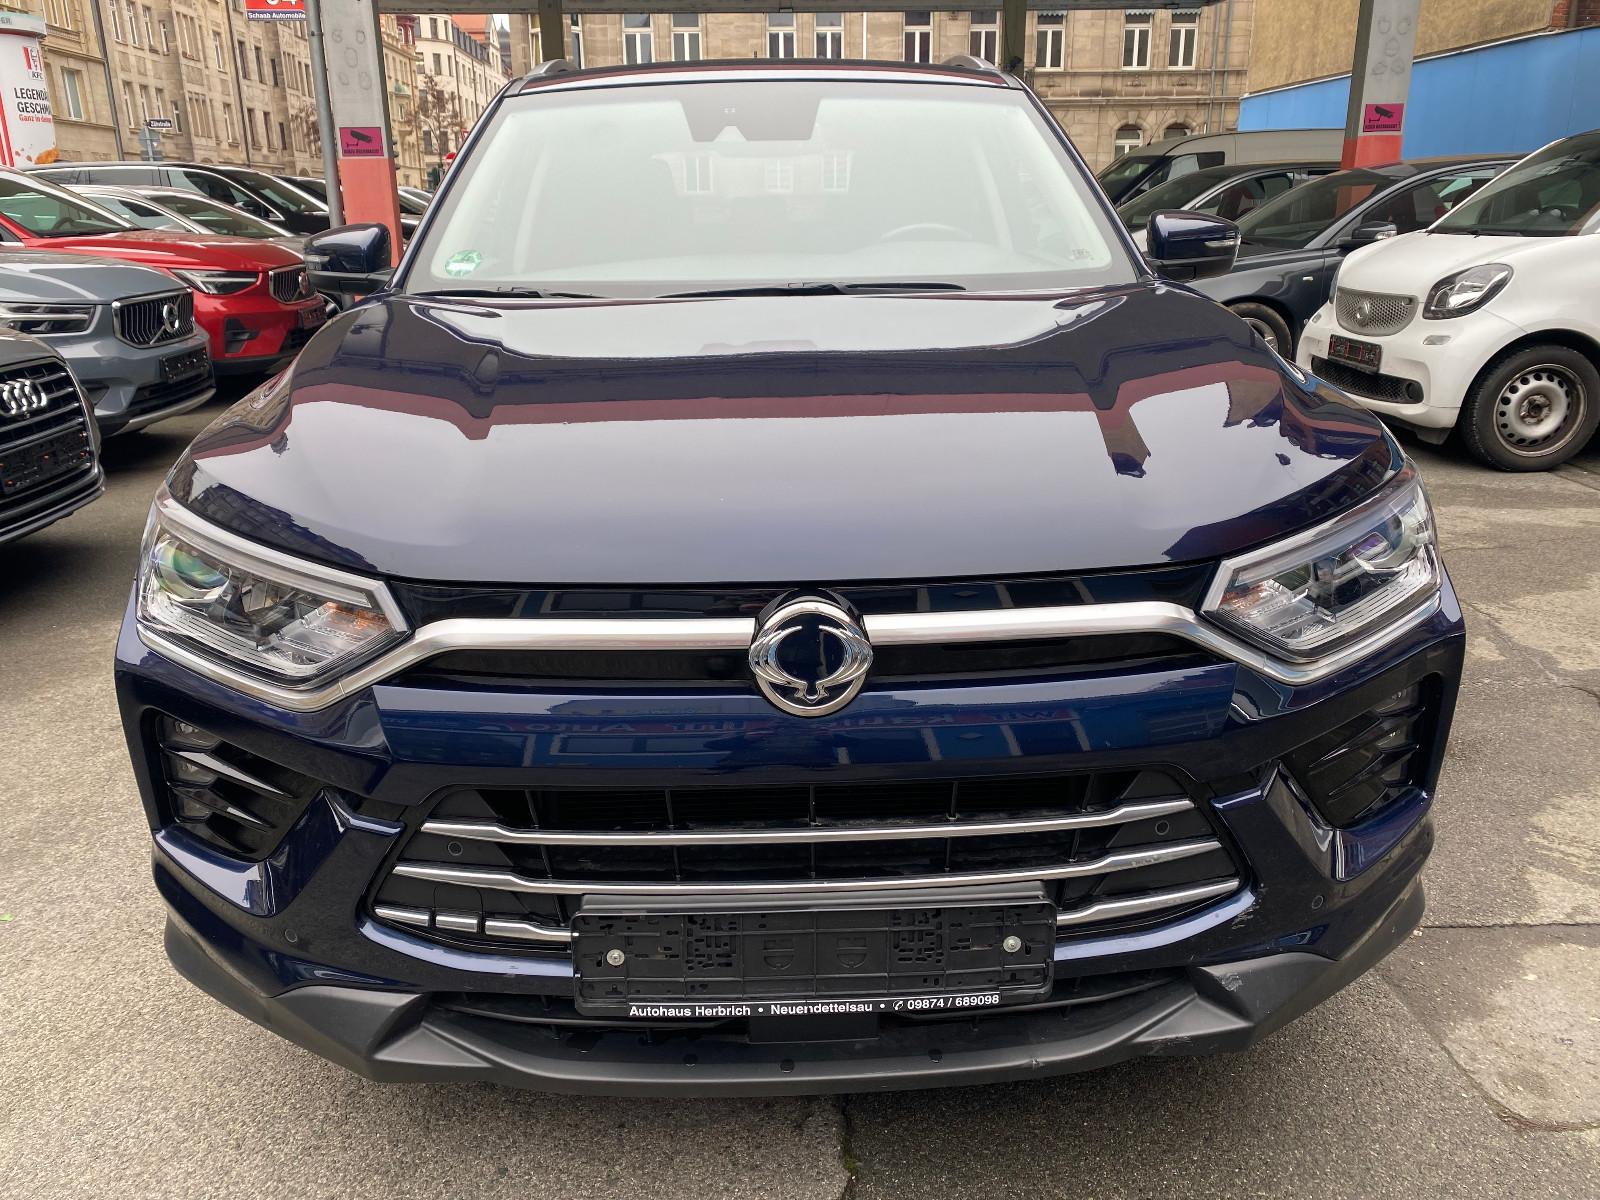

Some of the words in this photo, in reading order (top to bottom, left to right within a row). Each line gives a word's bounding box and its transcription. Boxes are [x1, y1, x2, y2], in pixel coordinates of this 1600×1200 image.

[629, 1006, 692, 1017] Autohaus
[695, 1005, 751, 1016] Herbrich
[770, 1002, 873, 1015] Neuendettelsau
[907, 998, 945, 1010] 09874
[955, 994, 1000, 1007] 689098
